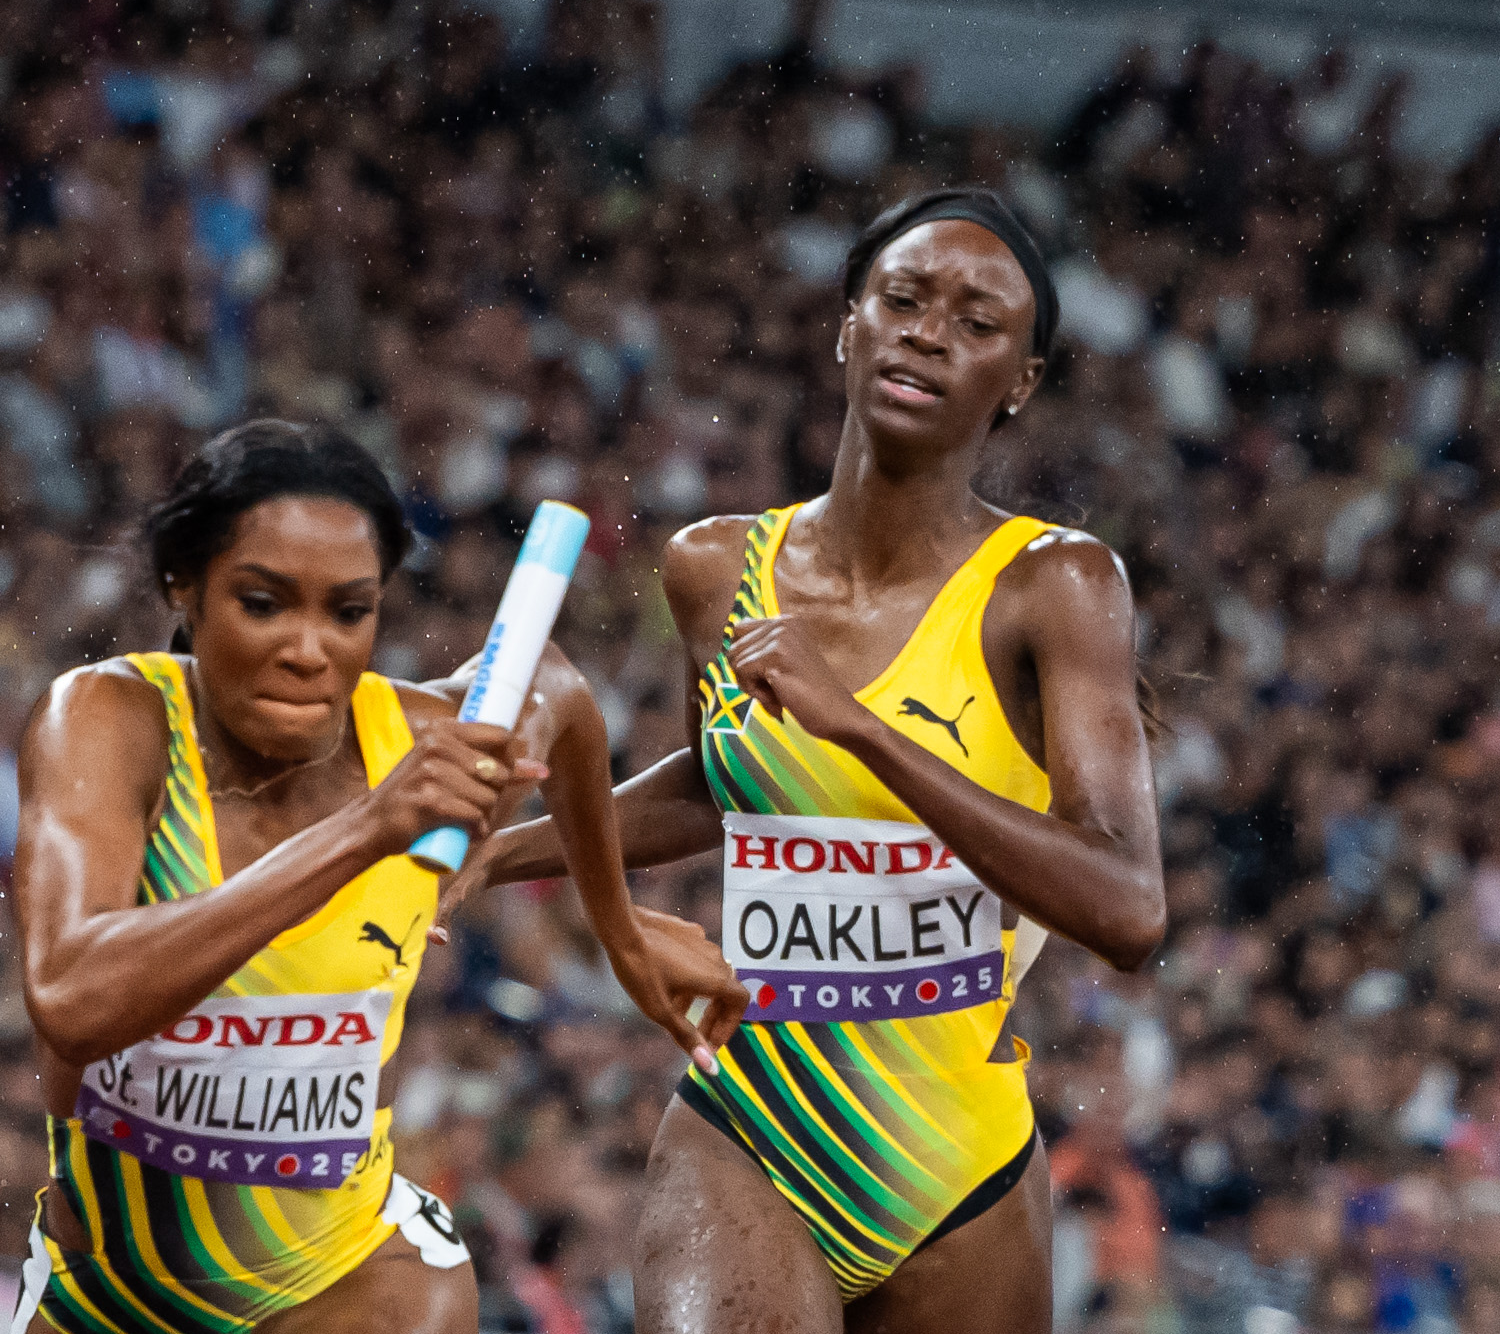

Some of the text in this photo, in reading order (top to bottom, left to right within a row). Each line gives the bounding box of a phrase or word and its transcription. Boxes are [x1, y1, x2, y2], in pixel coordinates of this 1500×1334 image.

[738, 891, 984, 963] OAKLEY
[951, 968, 993, 998] 25
[155, 1011, 377, 1047] ONDA
[99, 1051, 366, 1133] St. WILLIAMS
